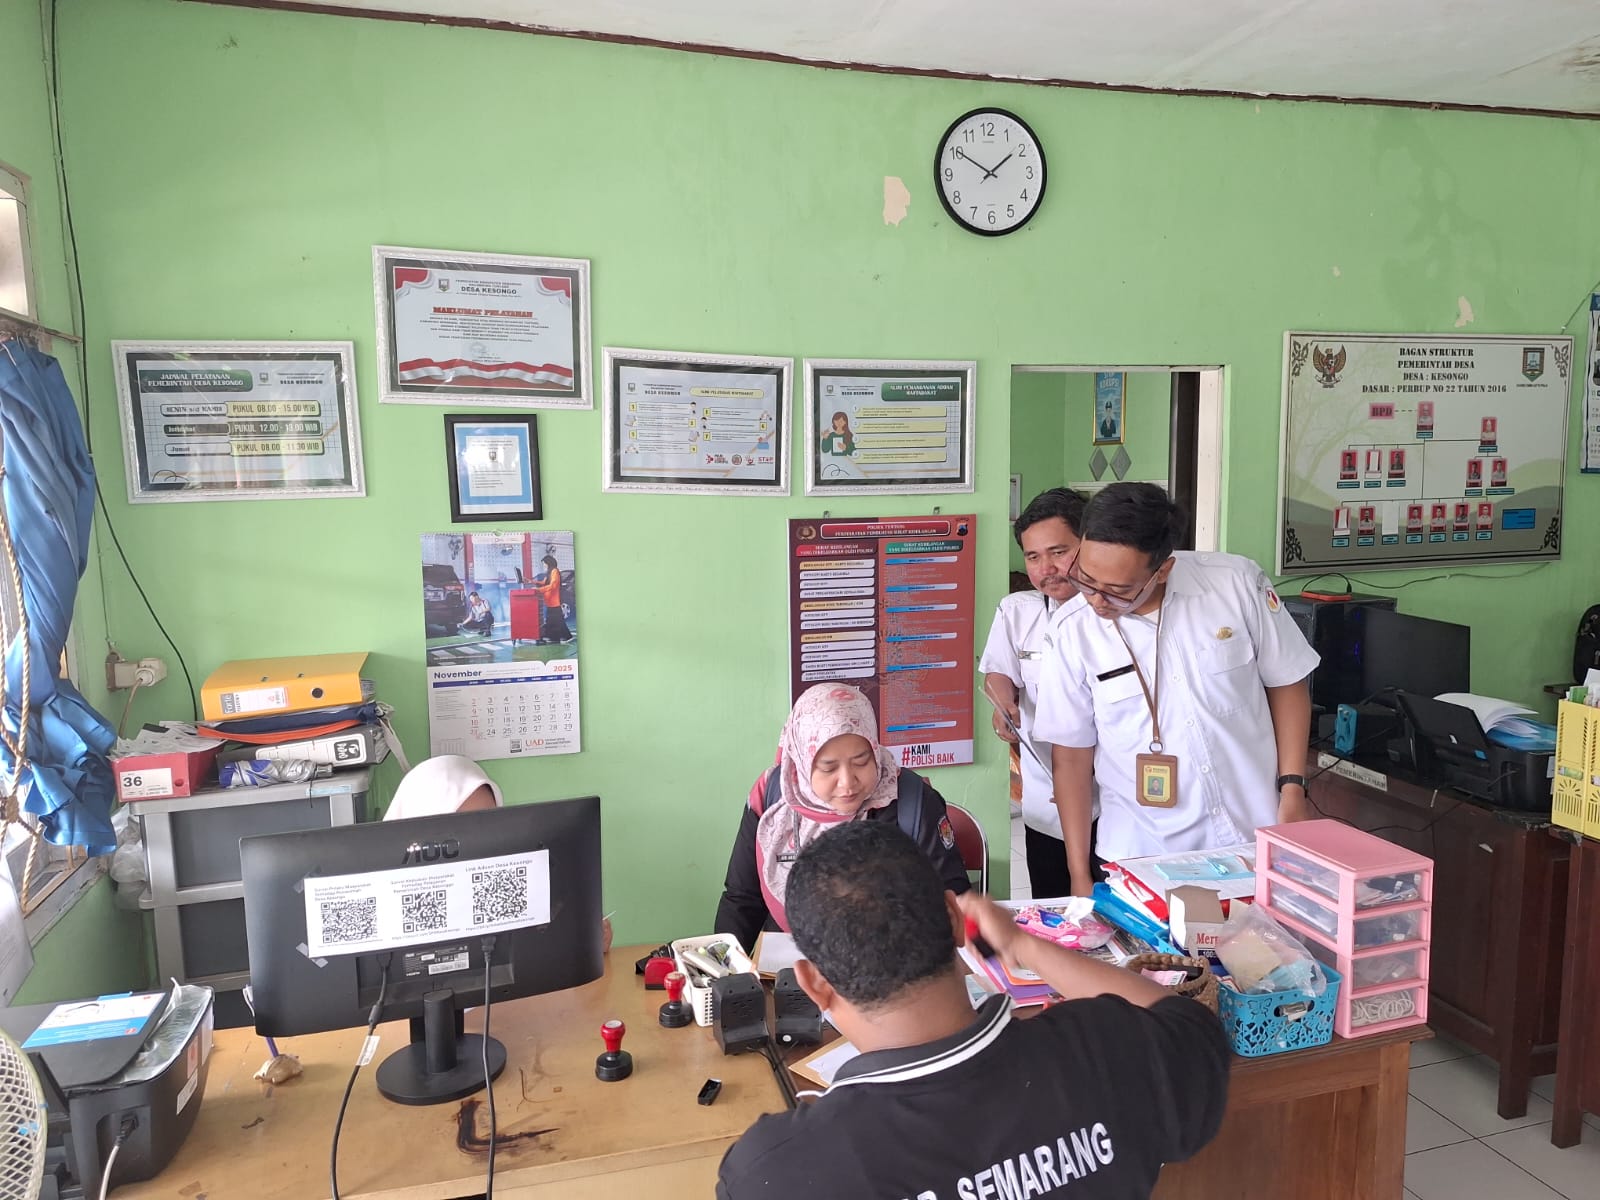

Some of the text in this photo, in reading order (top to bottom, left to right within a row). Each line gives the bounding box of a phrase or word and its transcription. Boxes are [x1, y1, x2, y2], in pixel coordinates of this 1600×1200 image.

[963, 129, 974, 143] 11
[980, 123, 994, 136] 12
[1004, 129, 1009, 142] 1
[950, 146, 963, 160] 10
[1018, 144, 1026, 157] 2
[945, 168, 952, 181] 9
[1026, 166, 1033, 179] 3
[953, 191, 961, 204] 8
[1020, 188, 1028, 201] 4
[970, 206, 977, 220] 7
[988, 211, 996, 224] 6
[1007, 205, 1014, 217] 5
[1400, 348, 1427, 356] BAGAN
[1398, 360, 1451, 369] PEMERINTAH
[1431, 372, 1468, 380] KESONGO
[1362, 385, 1390, 393] DASAR
[1397, 385, 1430, 393] PERBUP
[1372, 407, 1392, 416] BPD
[434, 670, 482, 679] November
[526, 739, 544, 747] UAD
[911, 752, 954, 765] POLISI BAIK
[123, 776, 142, 787] 36
[957, 1122, 1114, 1200] SEMARANG
